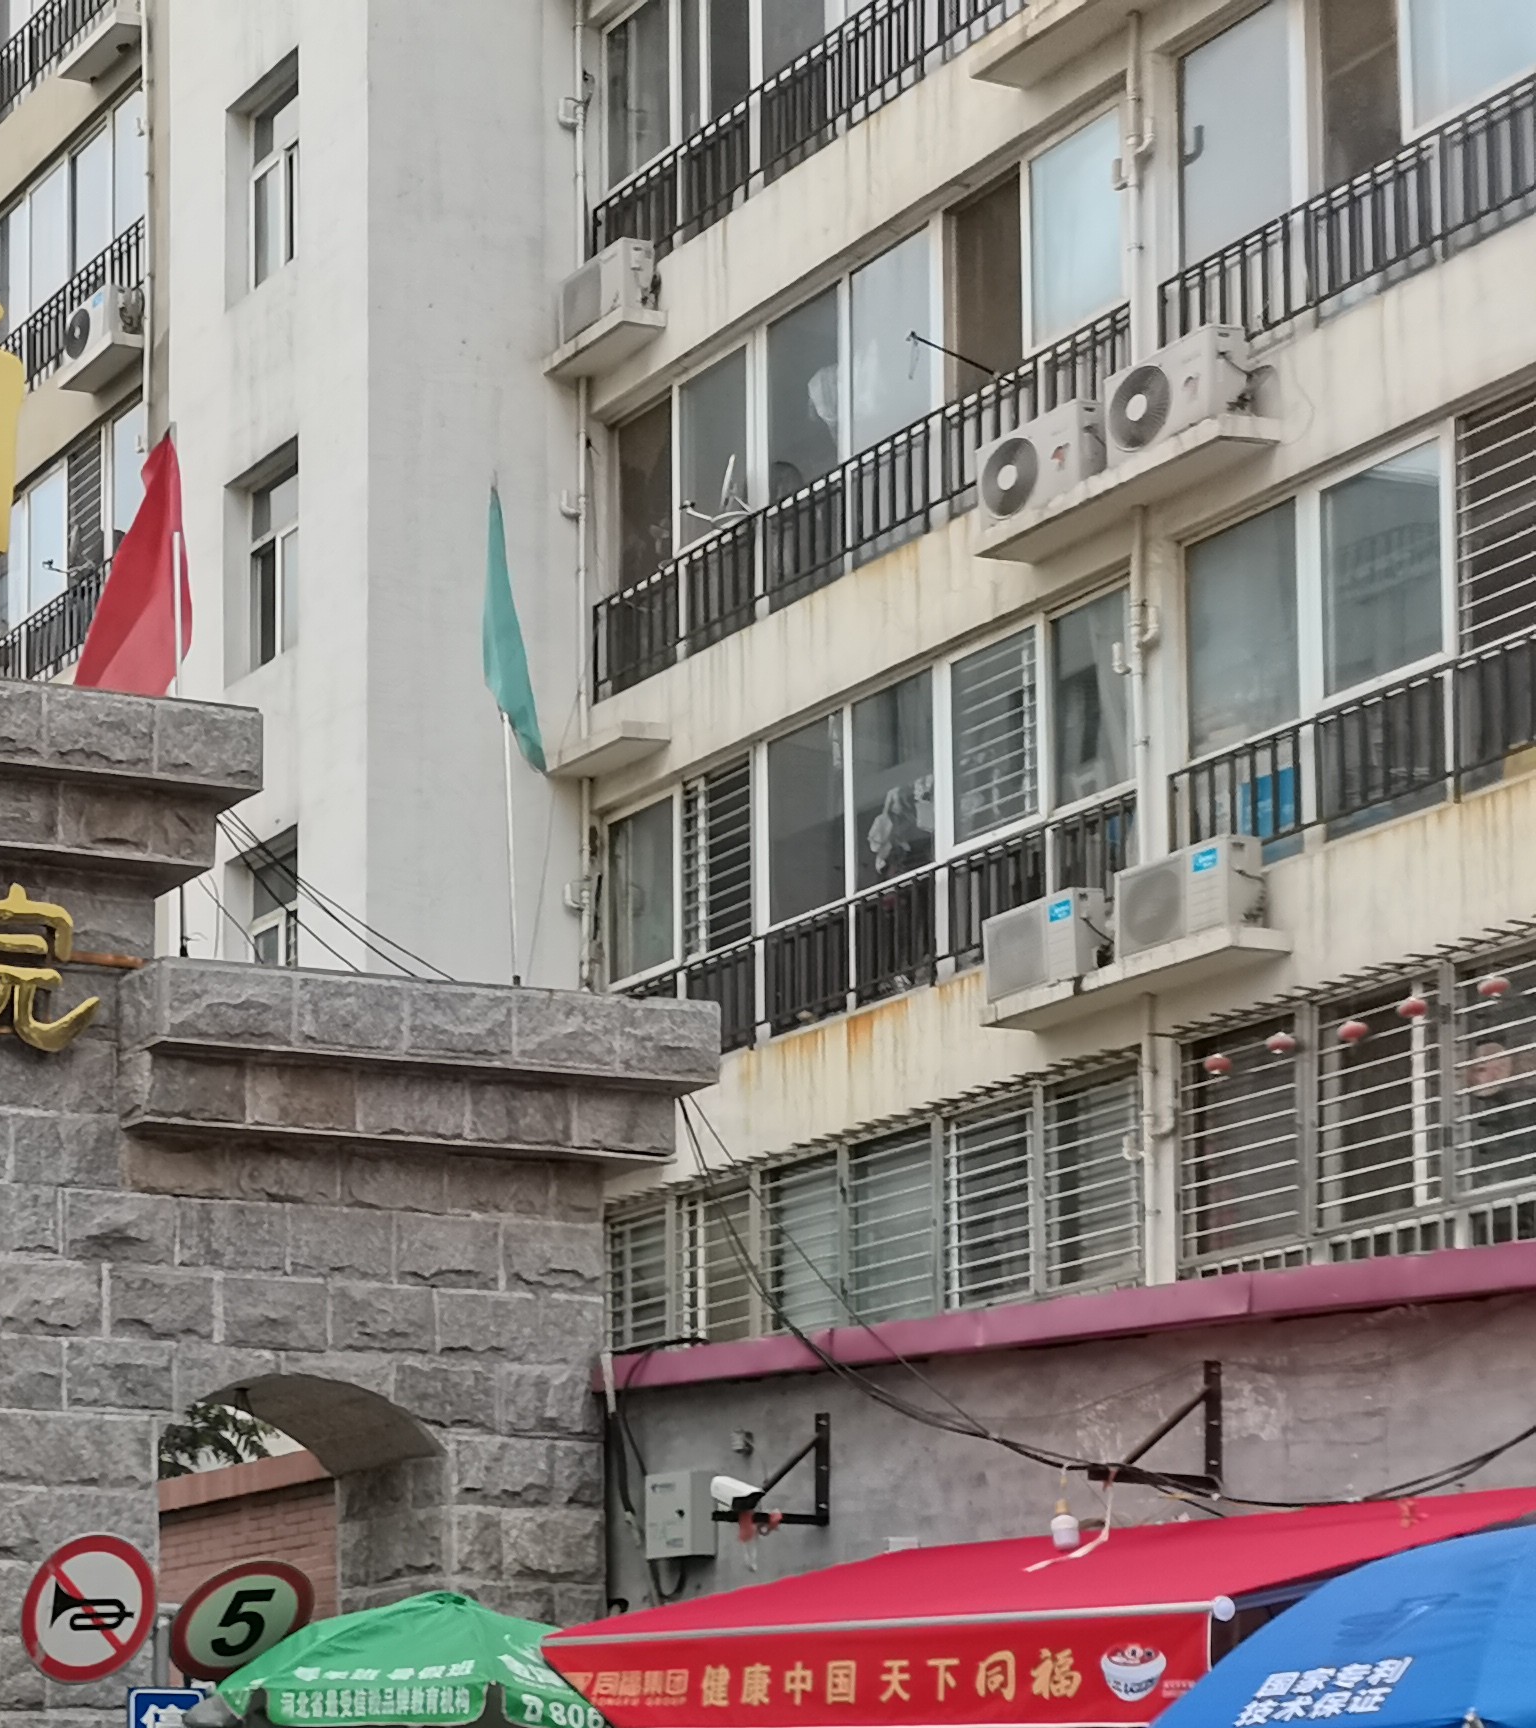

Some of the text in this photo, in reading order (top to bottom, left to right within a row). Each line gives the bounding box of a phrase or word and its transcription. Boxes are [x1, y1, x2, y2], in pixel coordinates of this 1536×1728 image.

[210, 1588, 277, 1657] 5
[701, 1648, 1083, 1707] 健康中国 天下同福
[1253, 1656, 1414, 1699] 国家专利
[1233, 1686, 1393, 1728] 技术保证
